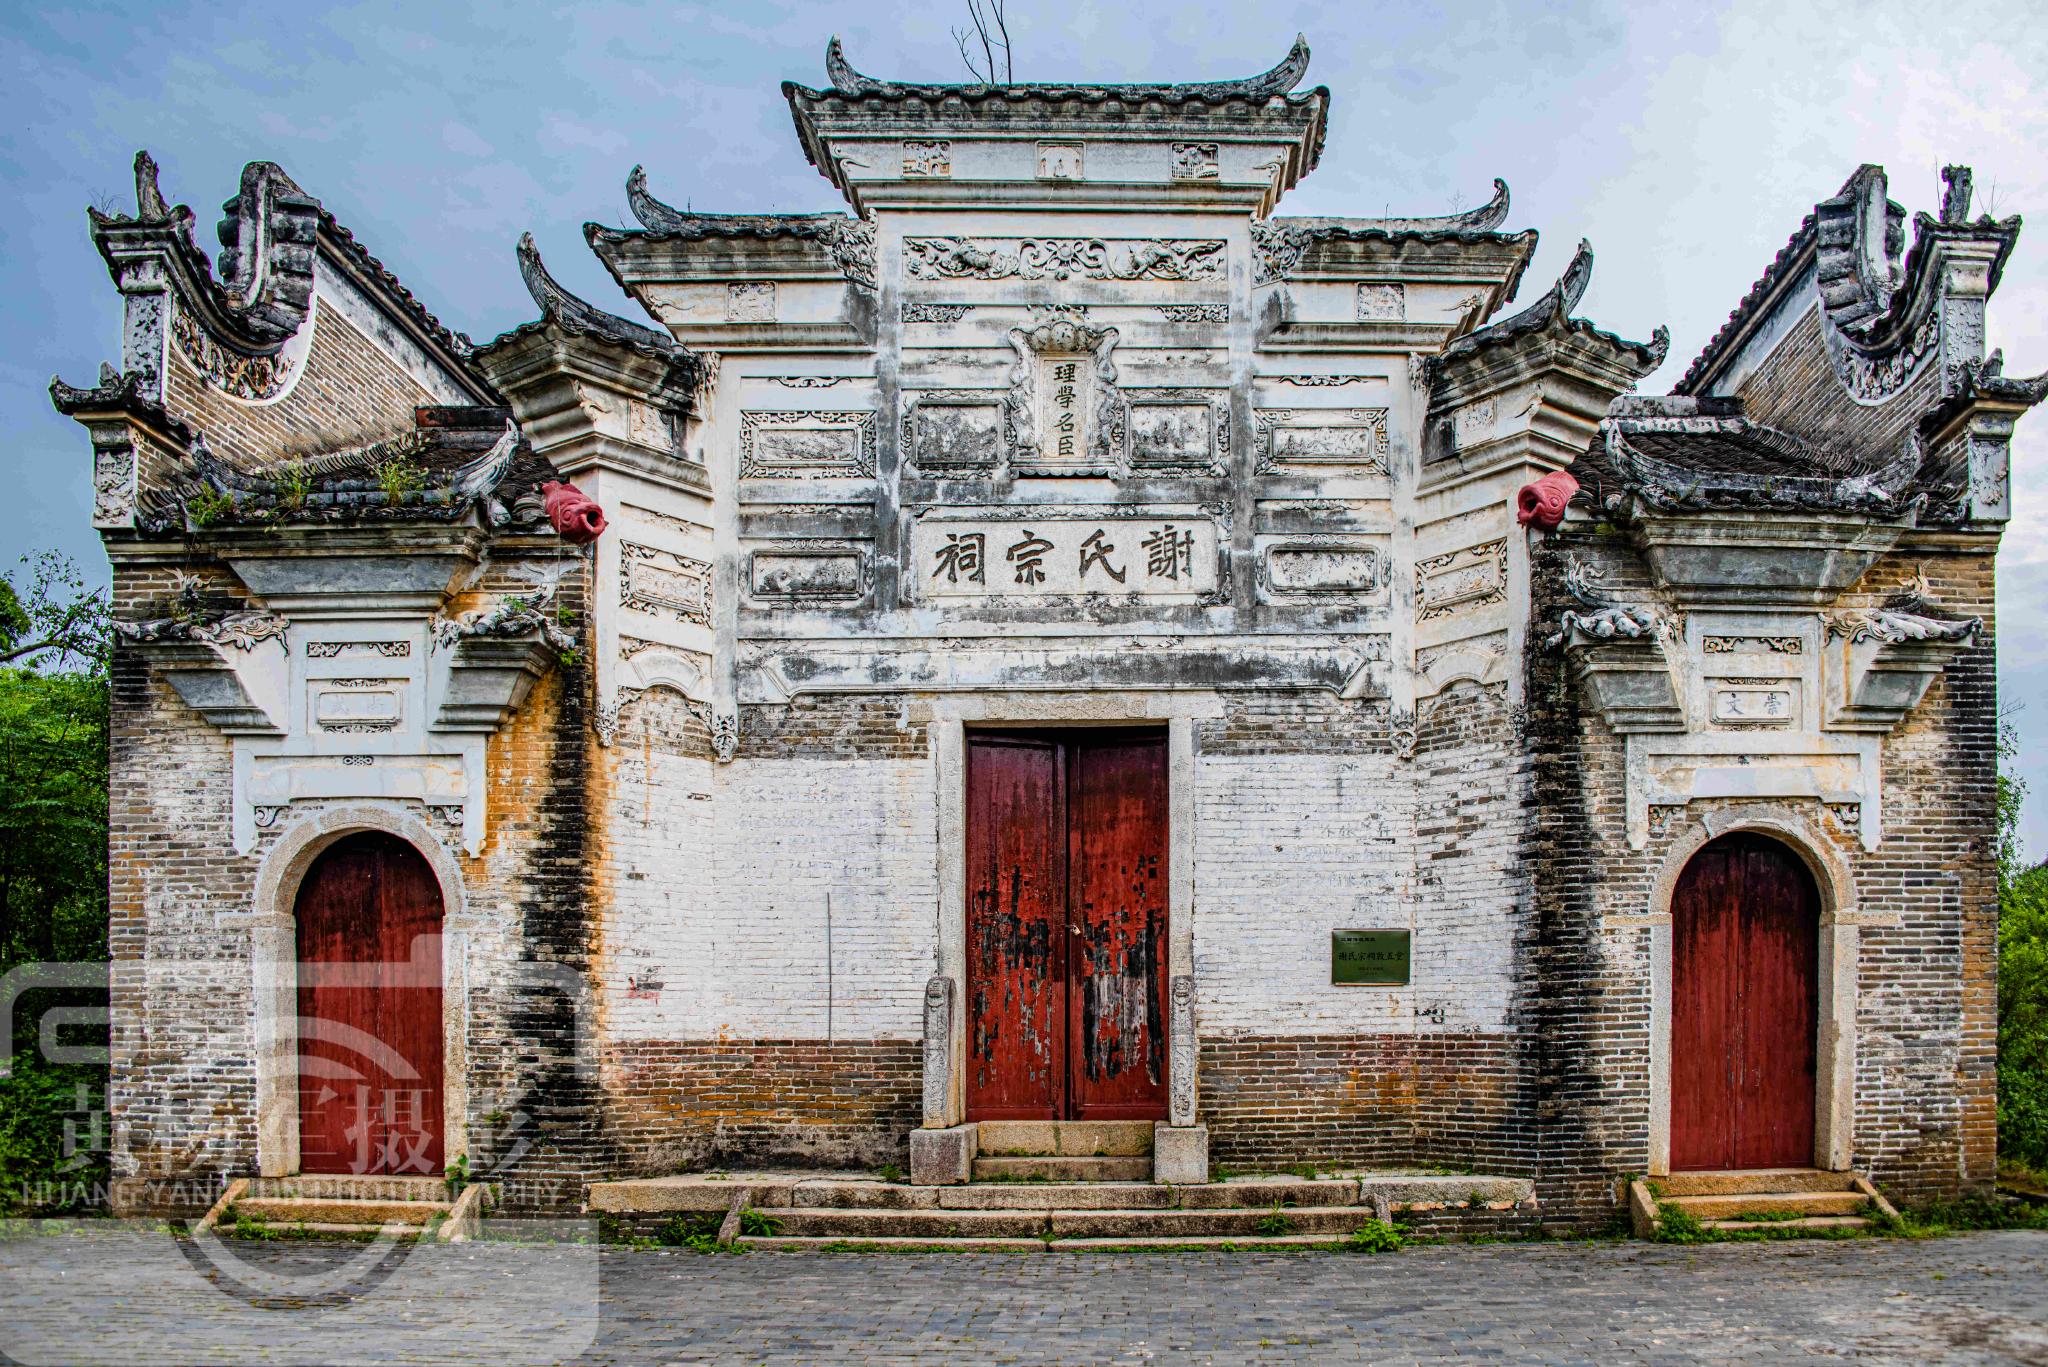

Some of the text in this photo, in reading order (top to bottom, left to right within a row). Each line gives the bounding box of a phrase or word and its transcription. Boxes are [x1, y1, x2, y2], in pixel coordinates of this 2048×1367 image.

[1053, 363, 1077, 457] 理學名臣
[931, 524, 1196, 587] 謝氏宗祠
